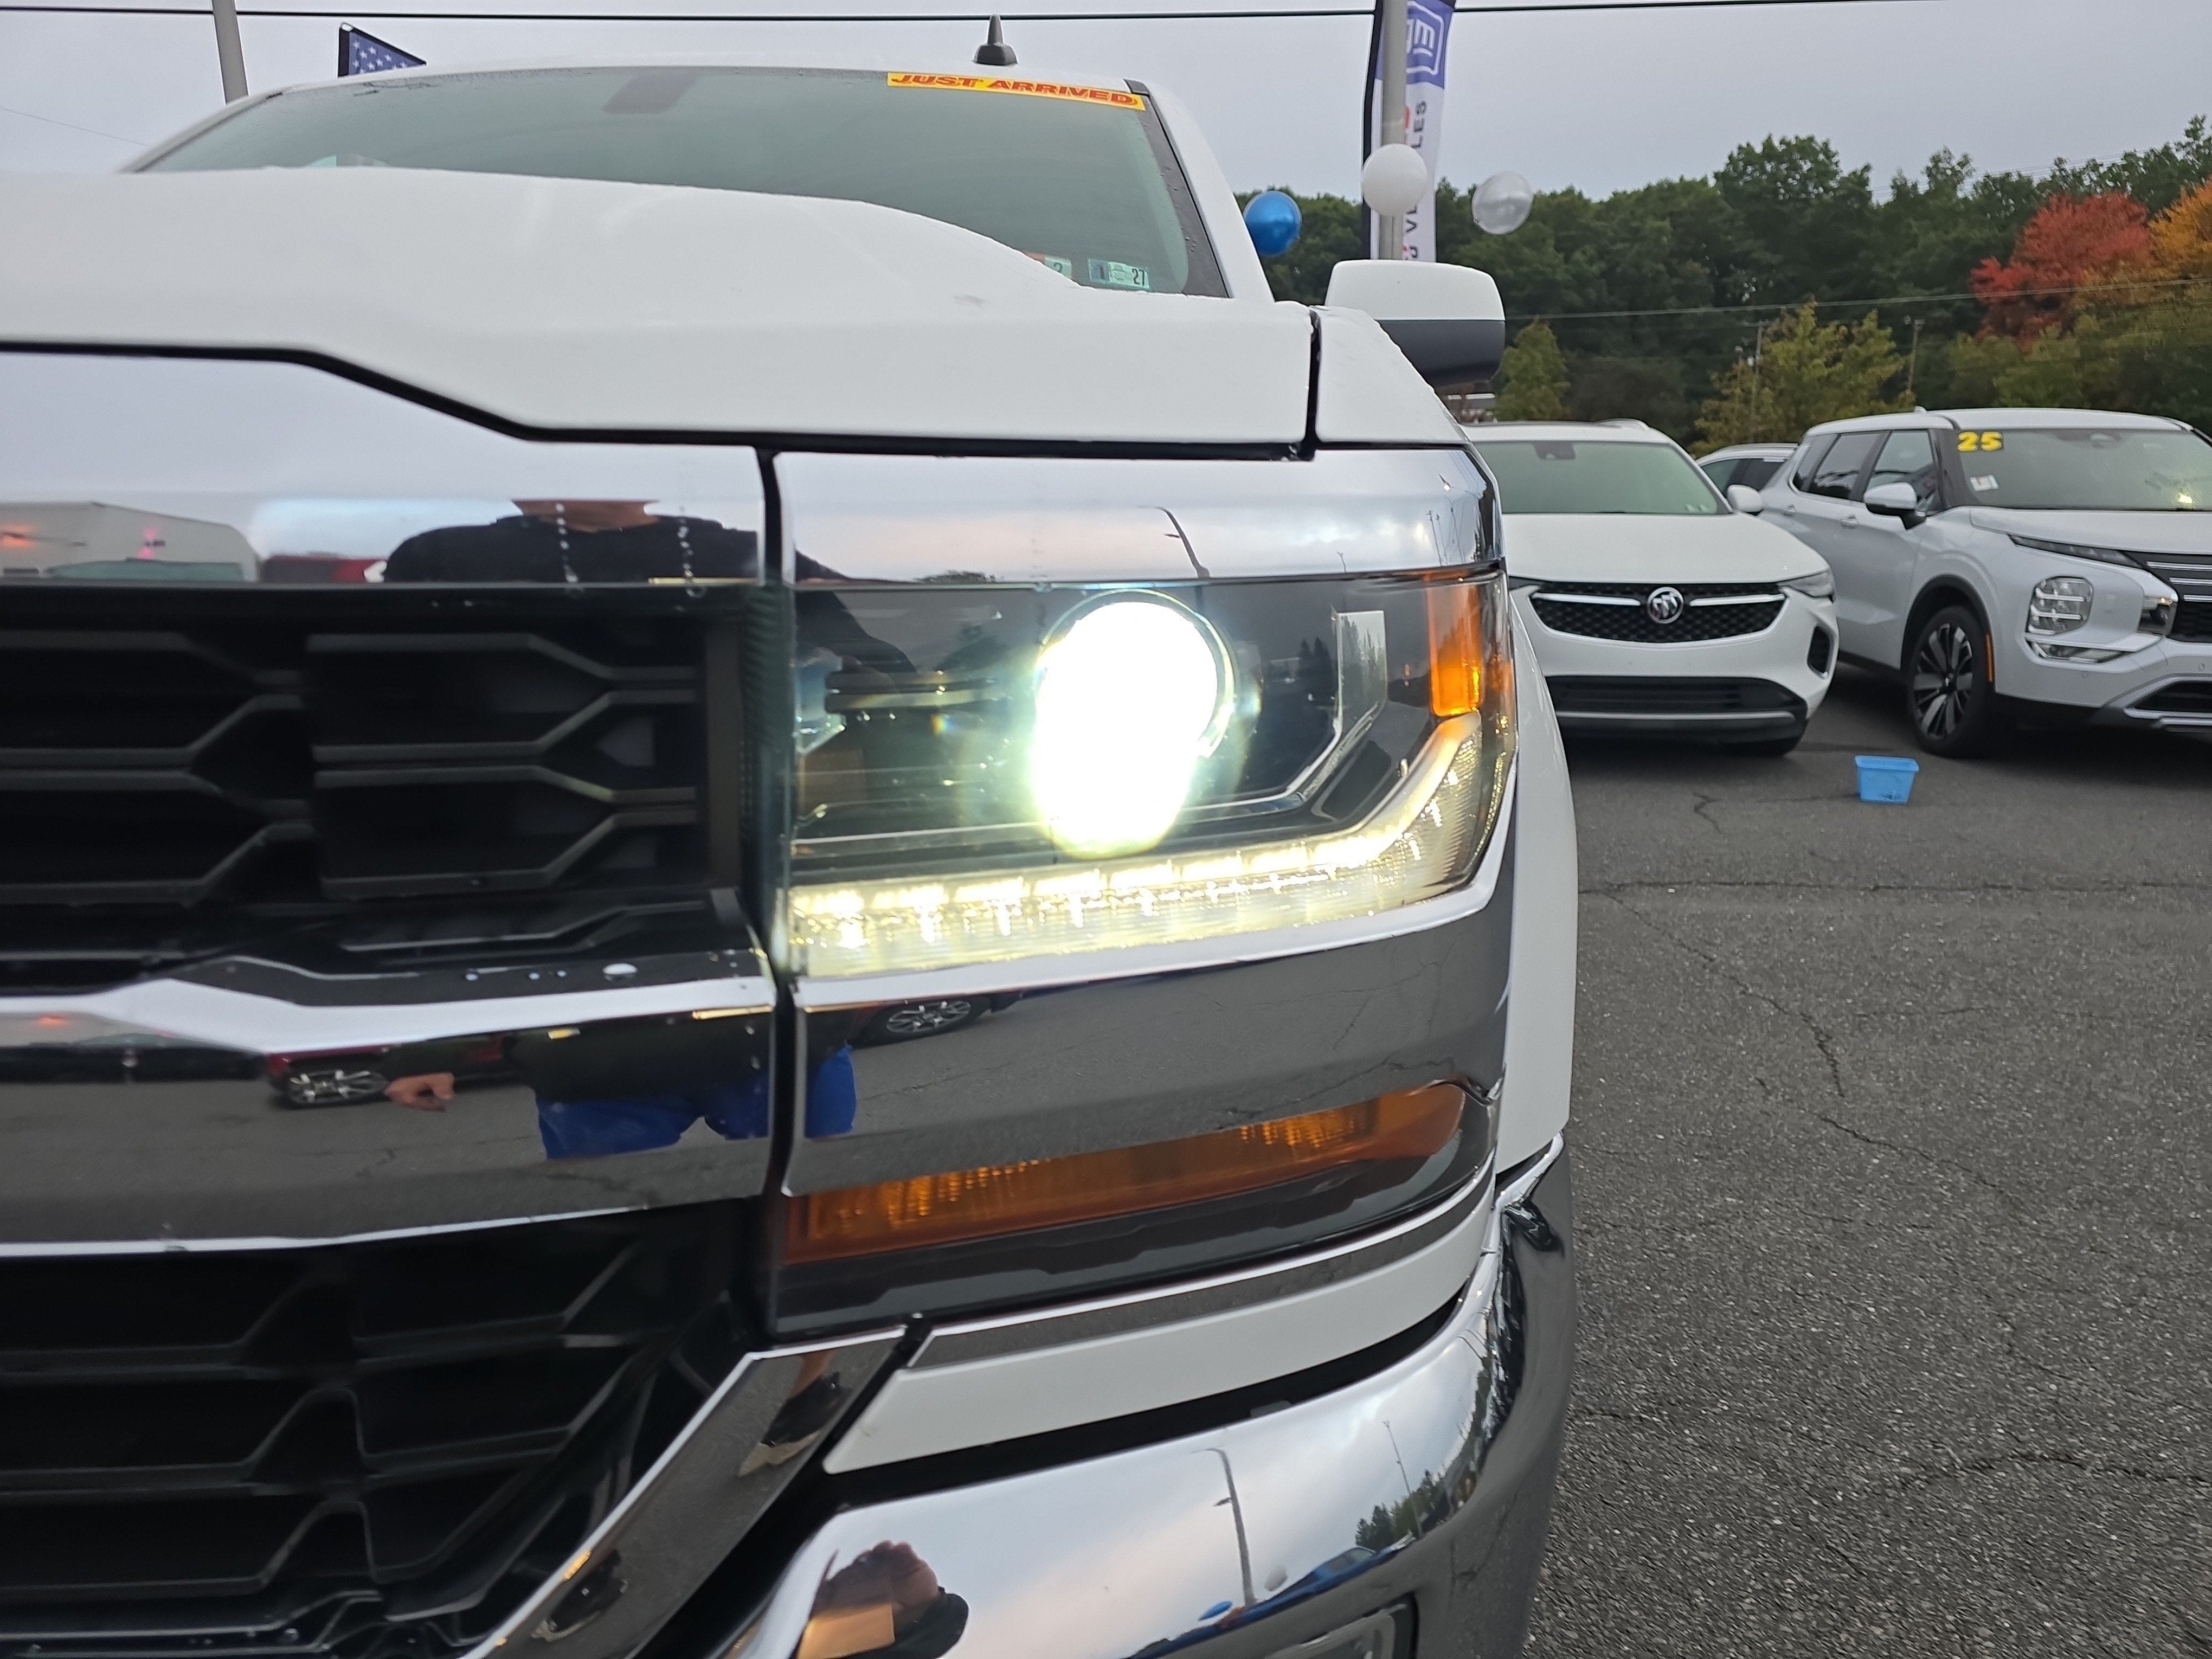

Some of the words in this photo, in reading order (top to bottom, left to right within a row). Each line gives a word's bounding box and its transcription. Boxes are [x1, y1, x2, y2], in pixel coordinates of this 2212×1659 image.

[891, 75, 983, 88] JUST
[987, 80, 1139, 105] ARRIVED
[1131, 268, 1145, 286] 27
[1958, 430, 2003, 452] 25
